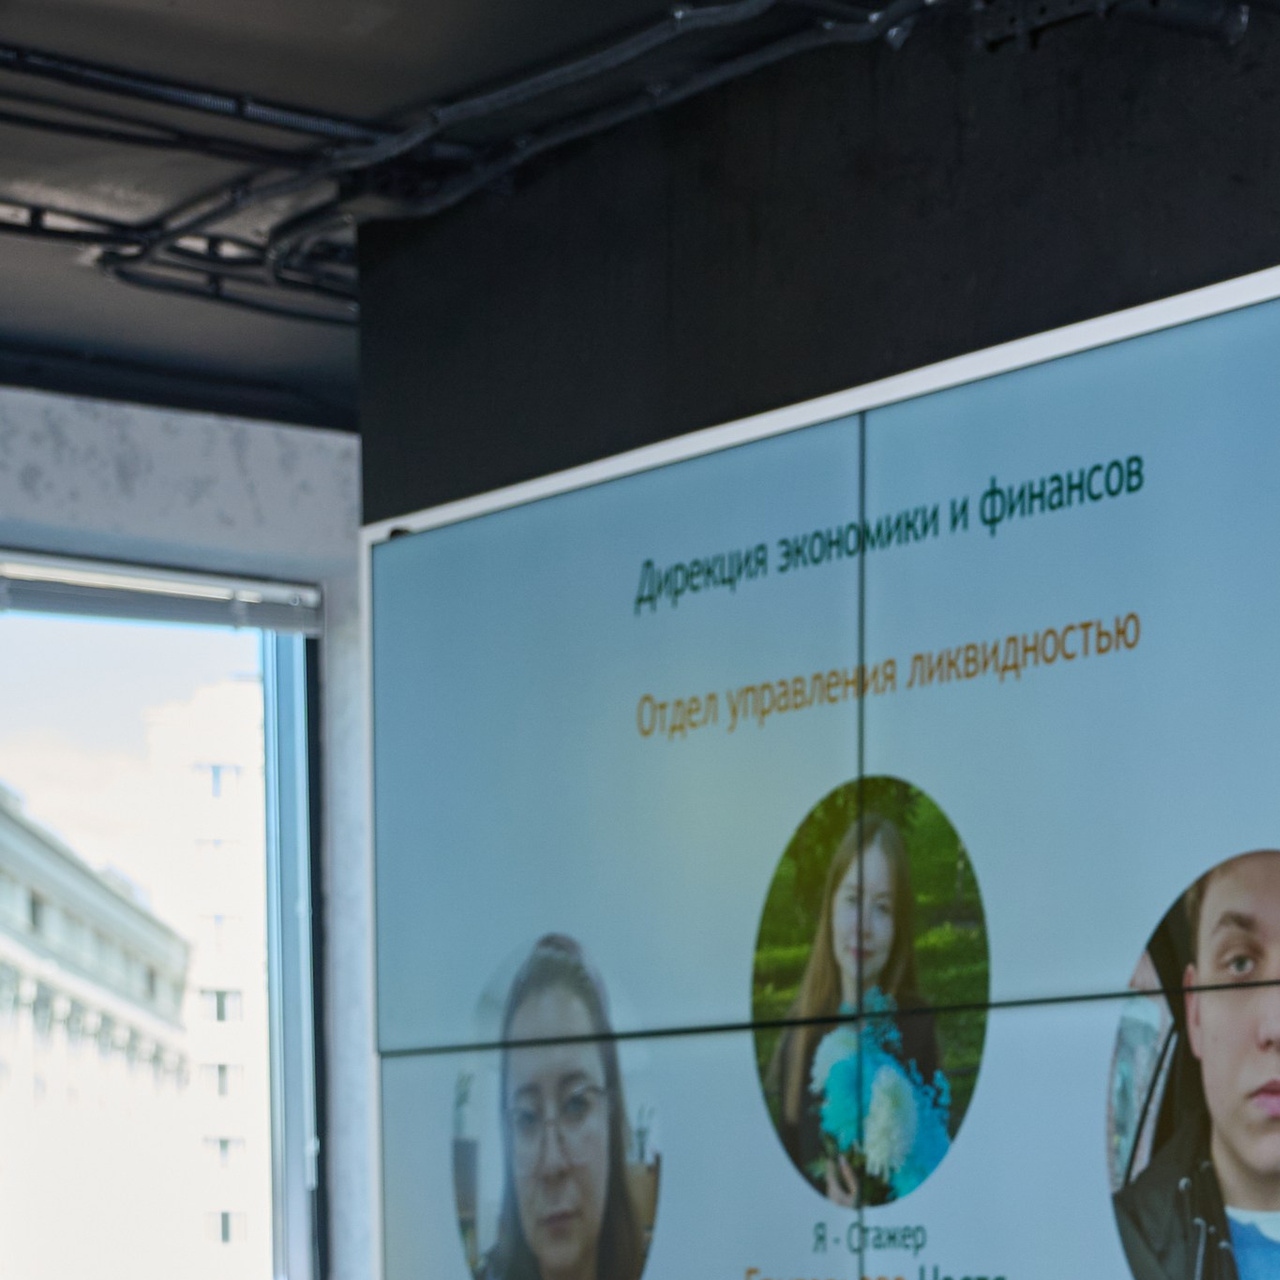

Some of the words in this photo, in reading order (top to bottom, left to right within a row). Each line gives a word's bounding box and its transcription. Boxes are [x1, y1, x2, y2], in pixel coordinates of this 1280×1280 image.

[635, 541, 769, 615] Дирекция
[777, 503, 940, 573] экономики
[949, 496, 969, 532] и
[979, 454, 1144, 538] финансов
[636, 692, 719, 741] Отдел
[726, 658, 896, 733] управления
[905, 611, 1142, 689] ликвидностью
[813, 1221, 828, 1254] Я
[847, 1220, 928, 1258] Стажер
